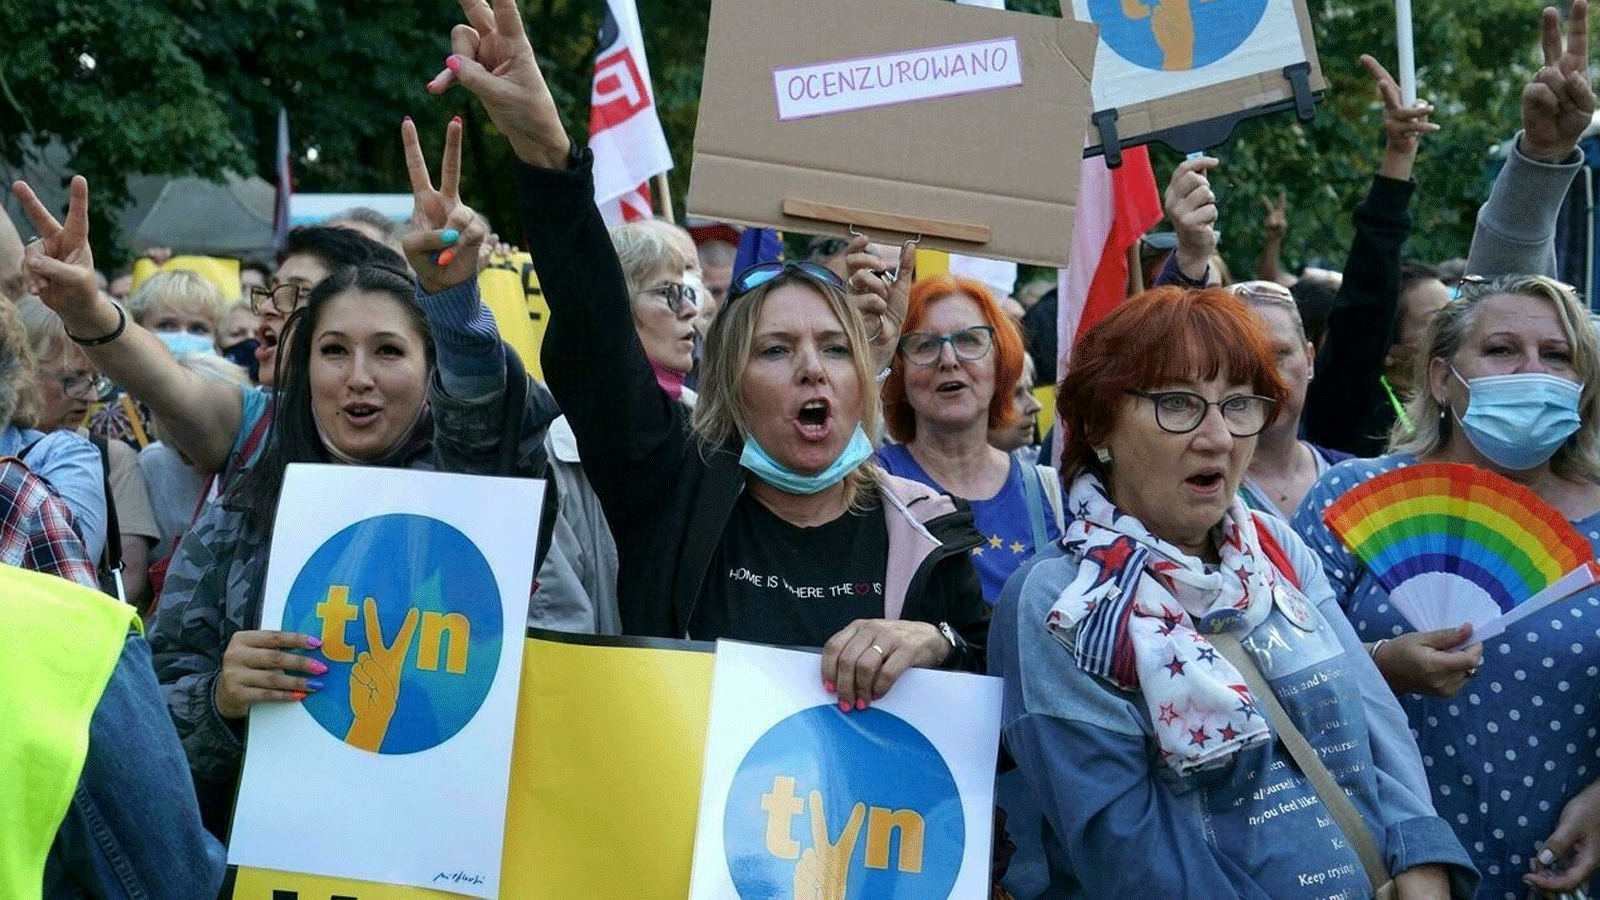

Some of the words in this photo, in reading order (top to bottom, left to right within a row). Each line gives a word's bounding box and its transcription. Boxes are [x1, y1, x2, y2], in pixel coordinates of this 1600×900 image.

[788, 47, 1008, 101] OCENZUROWANO
[729, 567, 763, 587] HOME
[767, 575, 779, 588] IS
[829, 582, 855, 597] THE
[872, 582, 883, 595] IS
[1301, 673, 1321, 690] and
[1278, 798, 1300, 814] feel
[1296, 795, 1319, 809] like
[1298, 872, 1326, 887] Keep
